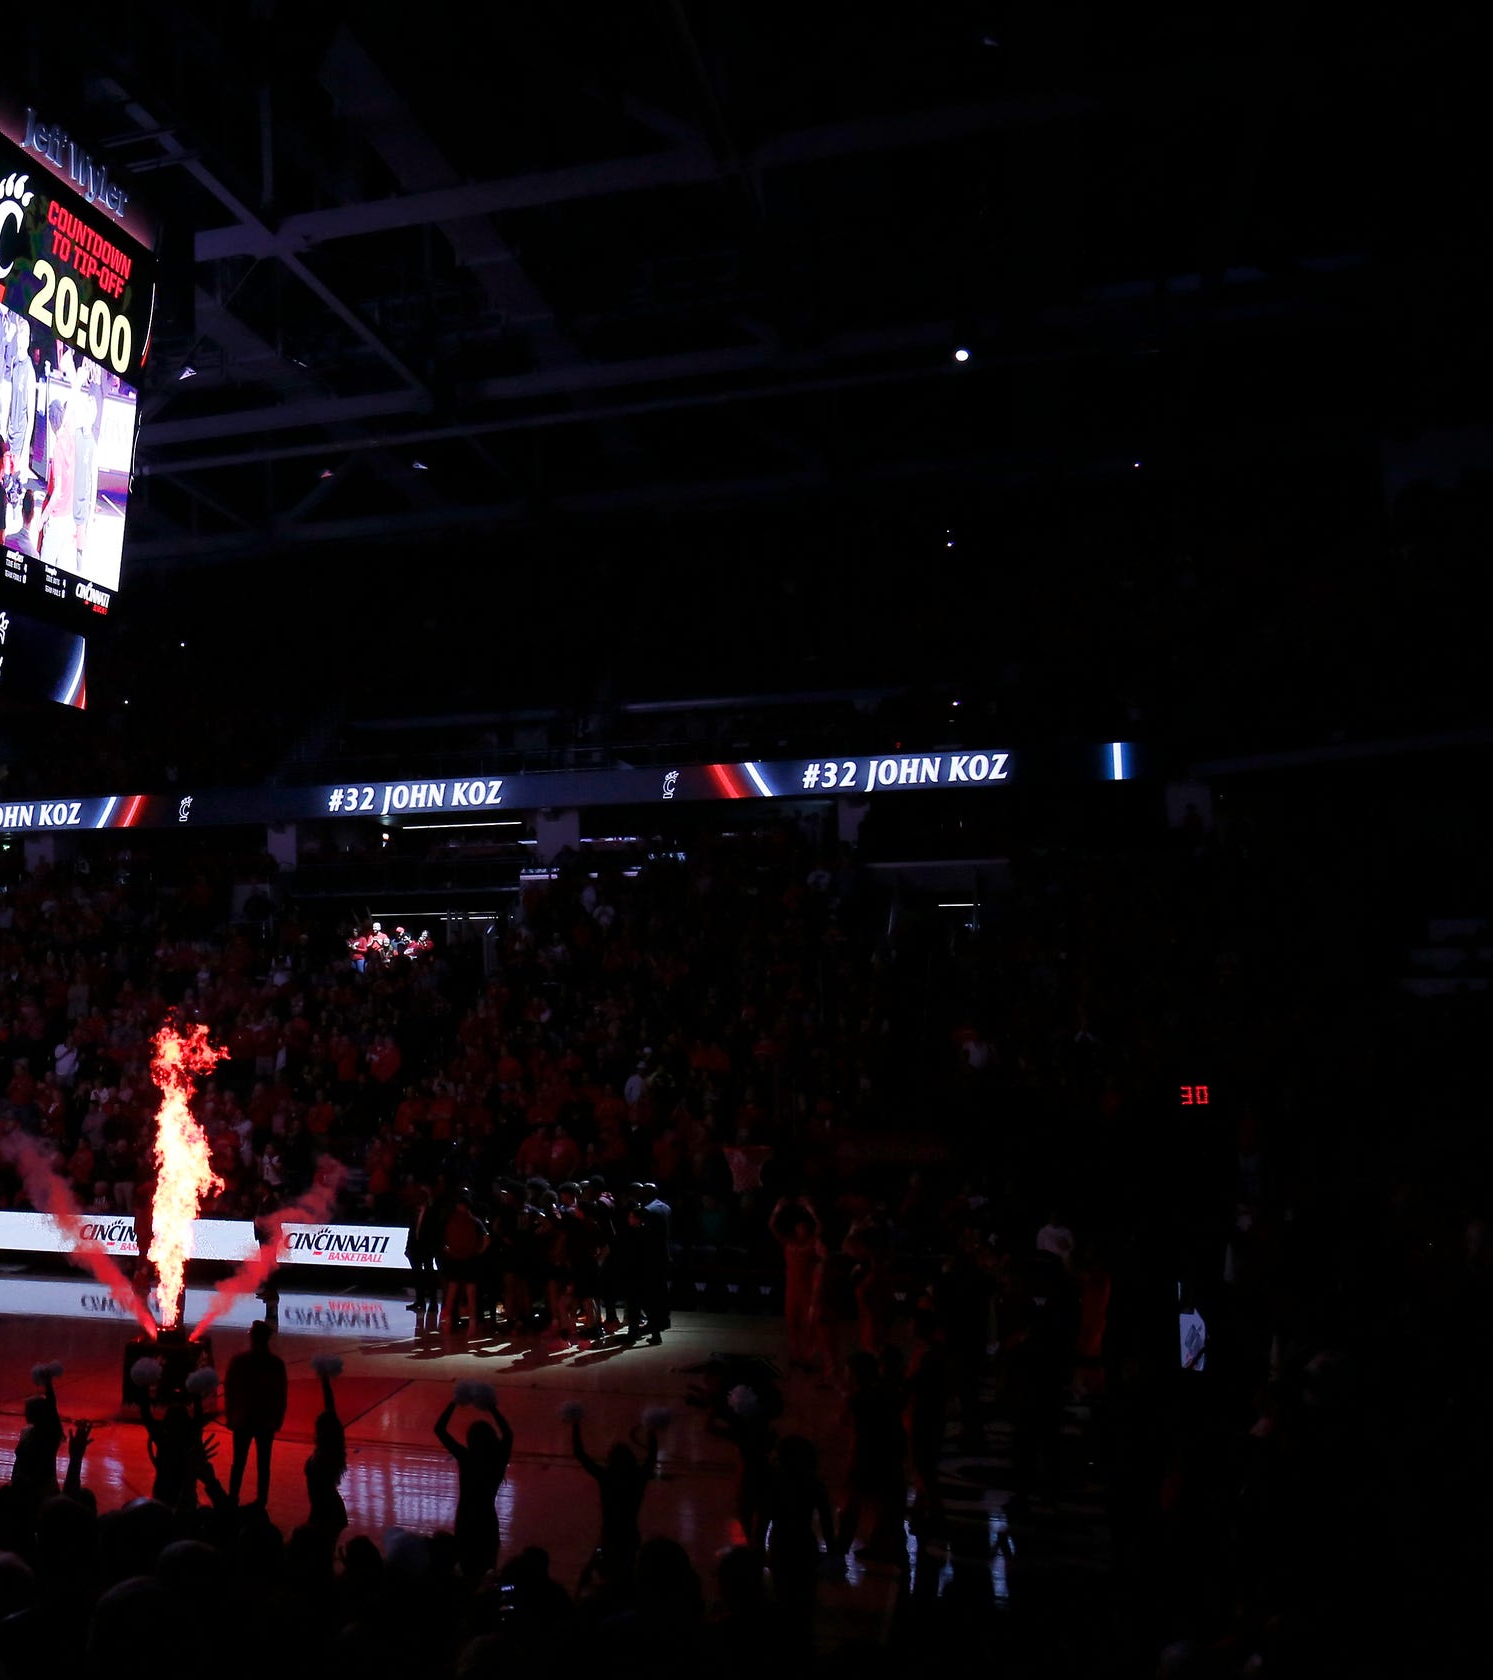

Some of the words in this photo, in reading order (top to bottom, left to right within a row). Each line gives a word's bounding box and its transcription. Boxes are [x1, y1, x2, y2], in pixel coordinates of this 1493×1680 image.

[47, 200, 132, 280] COUNTDOWN
[52, 230, 72, 263] TO
[73, 245, 125, 299] TIP-OFF
[28, 259, 132, 374] 20:00
[75, 582, 111, 609] CINCINNATI
[803, 761, 857, 789] #32
[864, 757, 942, 792] JOHN
[947, 753, 1009, 781] KOZ
[328, 786, 374, 812] #32
[380, 782, 446, 815] JOHN
[448, 780, 504, 807] KOZ
[38, 802, 82, 826] KOZ
[1179, 1085, 1210, 1105] 30
[79, 1220, 137, 1242] CINCIN
[283, 1228, 390, 1254] CINCINNATI
[328, 1252, 383, 1262] BASKETBALL
